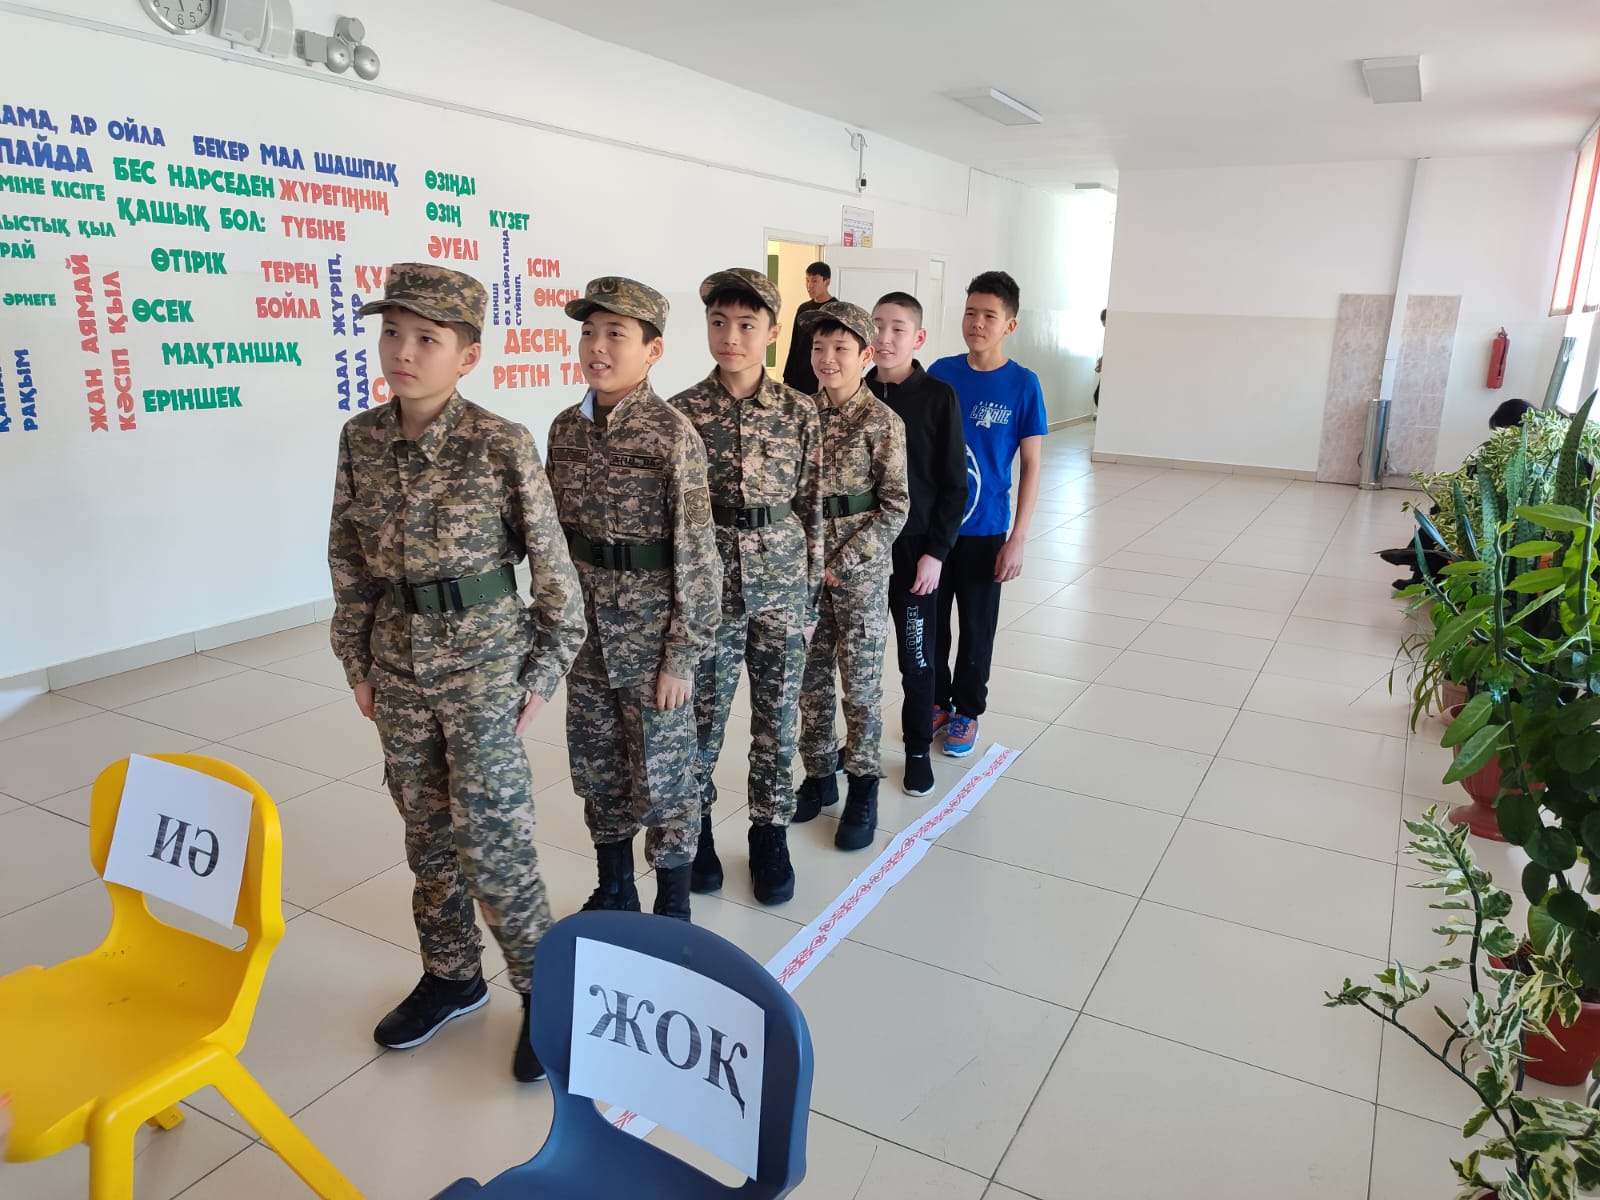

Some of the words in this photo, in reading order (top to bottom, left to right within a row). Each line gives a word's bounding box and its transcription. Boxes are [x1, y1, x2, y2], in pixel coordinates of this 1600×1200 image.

[0, 104, 58, 134] АМА,
[70, 114, 97, 135] АР
[107, 117, 165, 146] ОЙЛА
[0, 133, 93, 173] ПАЙДА
[192, 135, 250, 161] БЕКЕР
[259, 143, 304, 170] МАЛ
[314, 151, 399, 187] ШАШПАҚ
[51, 180, 105, 202] КІСІГЕ
[112, 156, 157, 185] БЕС
[167, 163, 275, 198] НАРСЕДЕН
[424, 169, 476, 197] ӨЗІҢДІ
[279, 179, 389, 216] ЖҮРЕГІҢНІҢ
[0, 214, 71, 237] ЫСТЫҚ
[77, 220, 116, 239] ҚЫЛ
[116, 196, 210, 233] ҚАШЫҚ
[219, 207, 266, 233] БОЛ:
[281, 215, 345, 241] ТҮБІНЕ
[425, 201, 462, 227] ӨЗІҢ
[489, 209, 530, 231] КҮЗЕТ
[150, 247, 227, 275] ӨТІРІК
[427, 235, 479, 260] ӘУЕЛІ
[260, 260, 319, 289] ТЕРЕҢ
[354, 265, 391, 294] ҚҰ
[527, 257, 561, 278] ІСІМ
[66, 254, 100, 353] АЯМАЙ
[102, 271, 128, 334] ҚЫЛ
[131, 298, 193, 323] ӨСЕК
[255, 292, 321, 319] БОЙЛА
[504, 310, 511, 326] ӨЗ
[161, 341, 302, 369] МАҚТАНШАҚ
[504, 328, 571, 357] ДЕСЕҢ,
[111, 349, 136, 431] КӘСІП
[335, 350, 351, 411] АДАЛ
[354, 349, 370, 409] АДАЛ
[493, 364, 550, 389] РЕТІН
[560, 362, 589, 386] ТА
[14, 349, 39, 432] РАҚЫМ
[84, 368, 108, 431] ЖАН
[142, 386, 242, 413] ЕРІНШЕК
[970, 405, 1012, 425] LEGUE
[915, 618, 928, 668] BOSTON
[147, 813, 219, 878] ИӘ
[586, 984, 748, 1119] ЖОҚ
